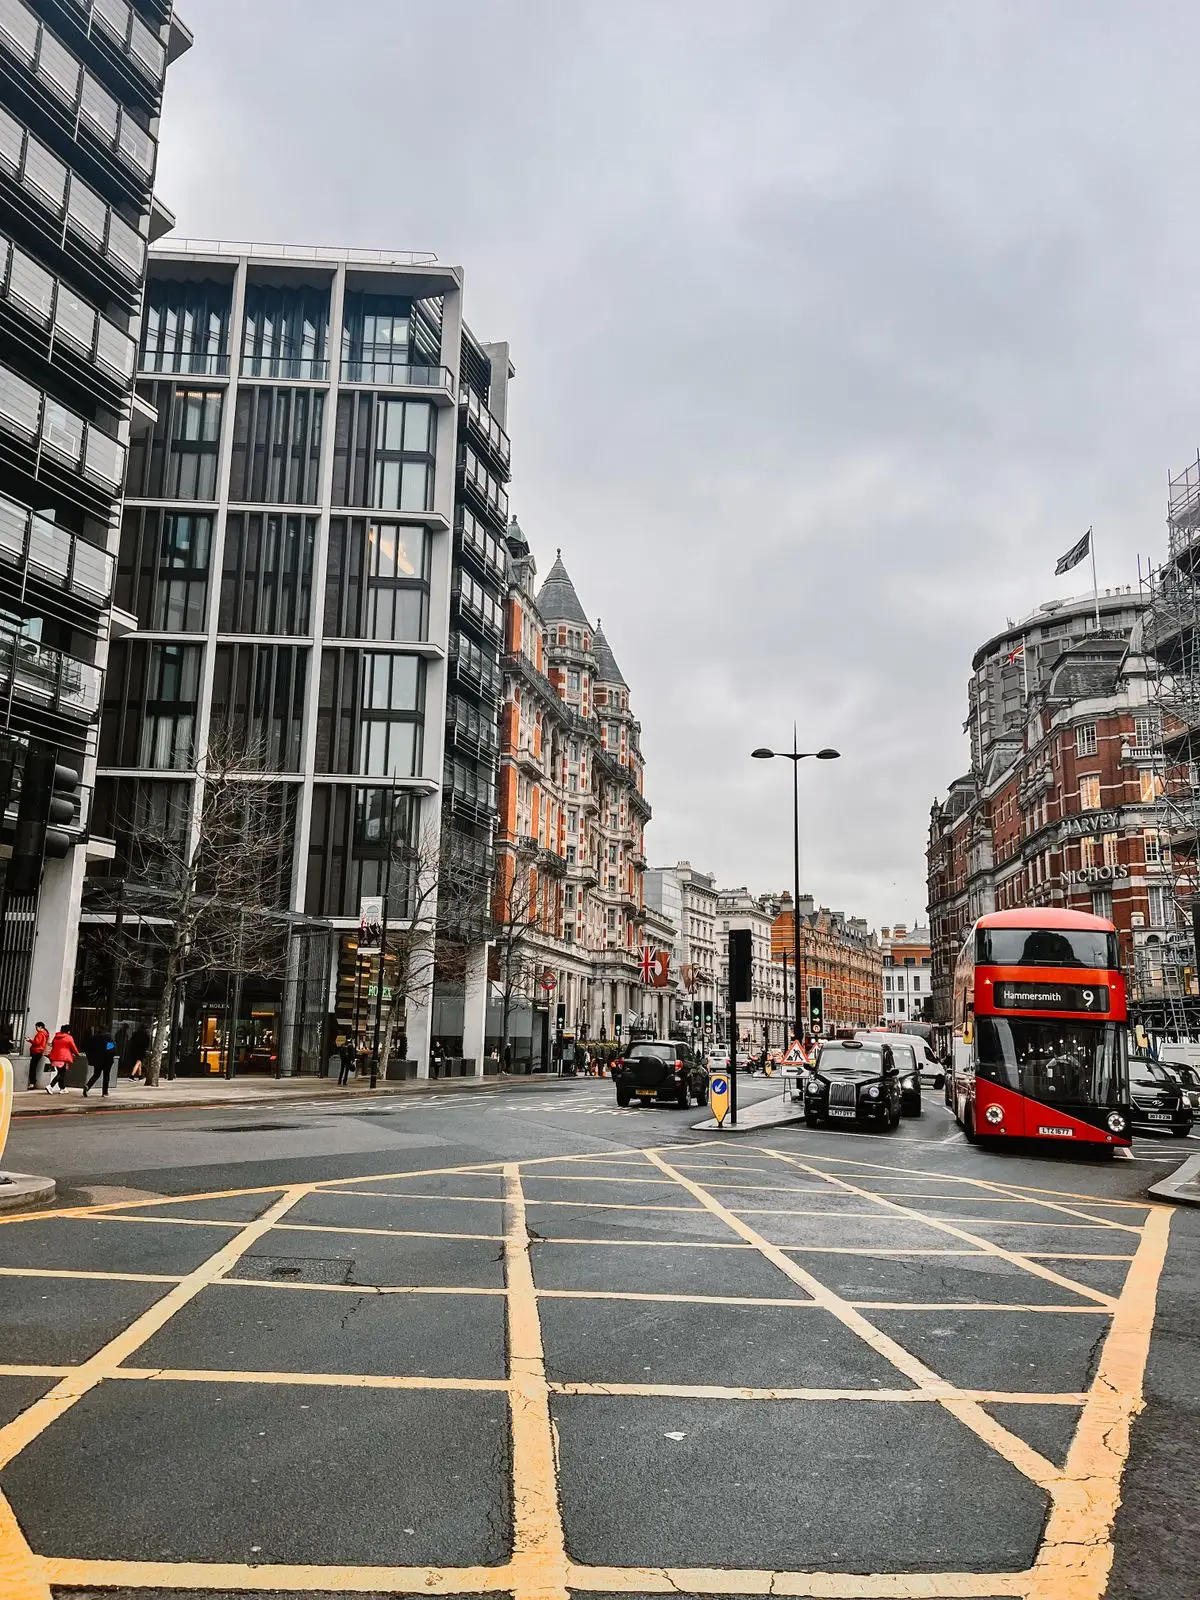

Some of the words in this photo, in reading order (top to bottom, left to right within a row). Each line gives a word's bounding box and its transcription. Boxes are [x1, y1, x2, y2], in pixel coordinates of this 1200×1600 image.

[1060, 813, 1118, 834] HARVEY
[1060, 864, 1128, 885] NICHOLS
[368, 985, 392, 998] ROEX
[1003, 990, 1061, 1001] Hammersmith
[1082, 989, 1094, 1006] 9
